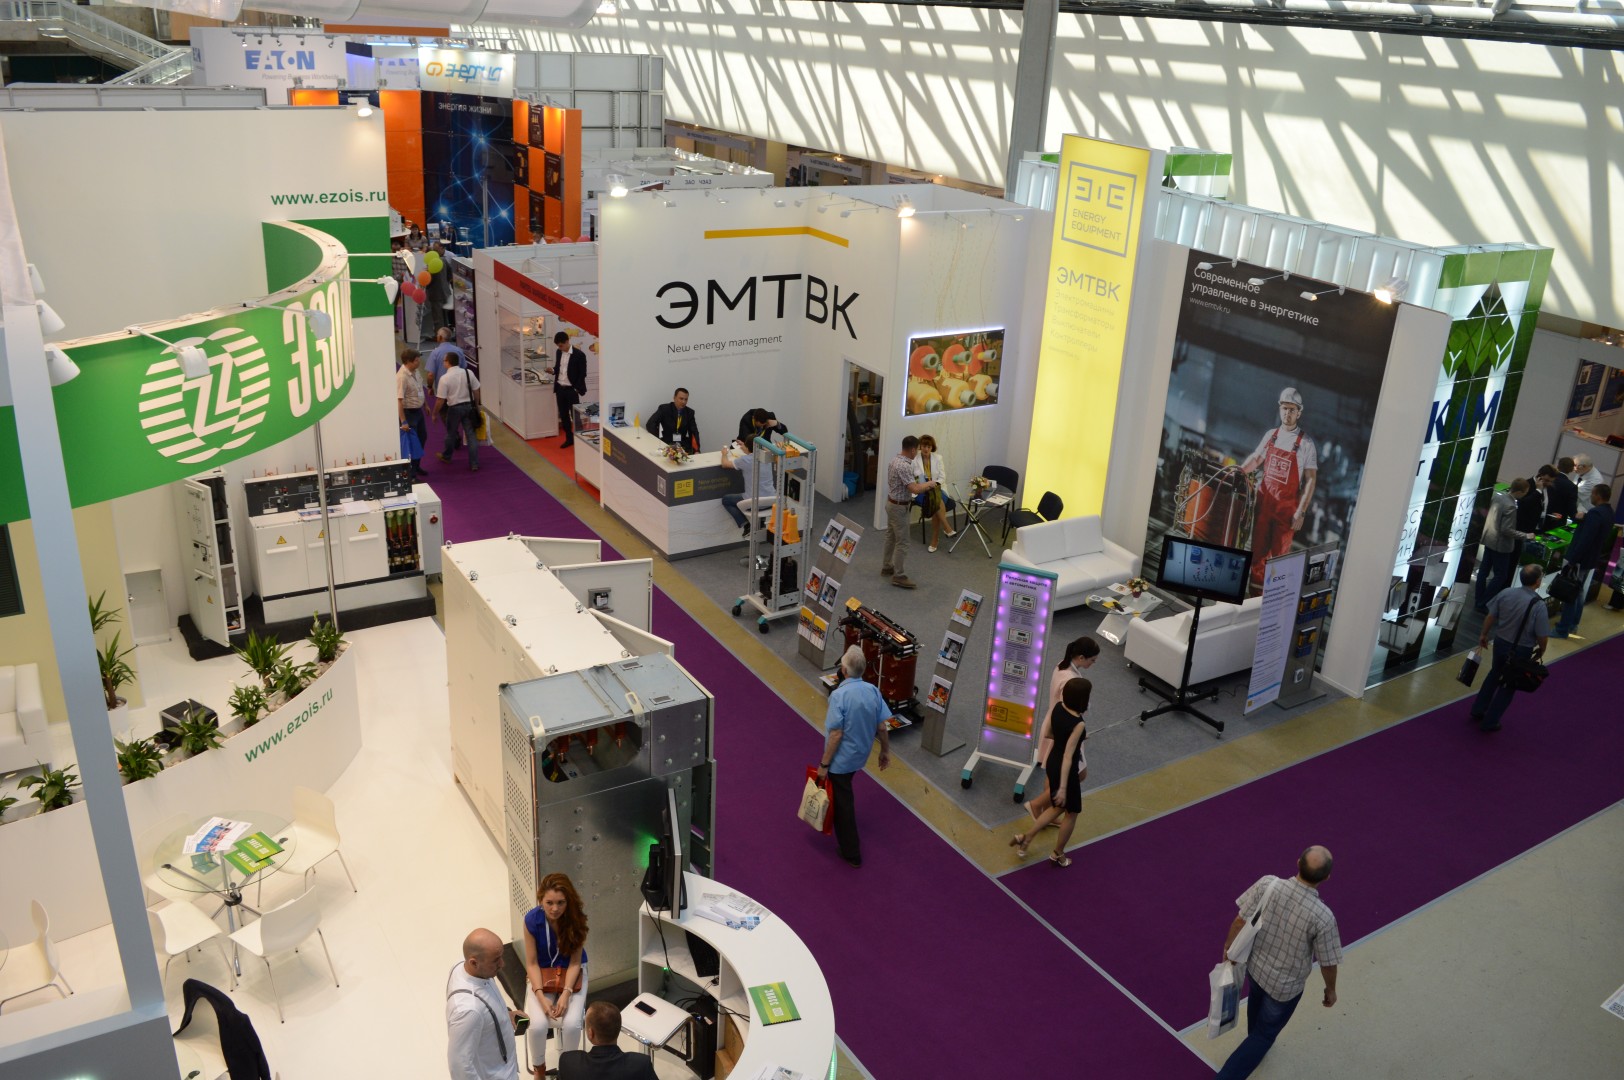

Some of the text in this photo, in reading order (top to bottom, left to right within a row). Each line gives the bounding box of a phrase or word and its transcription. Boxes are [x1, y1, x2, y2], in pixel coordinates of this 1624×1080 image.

[245, 50, 316, 70] EATON
[271, 189, 387, 206] www.ezois.ru
[1072, 208, 1107, 224] ENERGY
[1071, 220, 1122, 240] EQUIPMENT
[1056, 266, 1121, 302] ЭМТВК
[1194, 267, 1261, 294] Современное
[655, 273, 860, 340] ЭМТВК
[1191, 281, 1320, 327] управление в энергетике
[667, 335, 783, 354] New energy managment
[245, 687, 334, 763] www.ezois.ru
